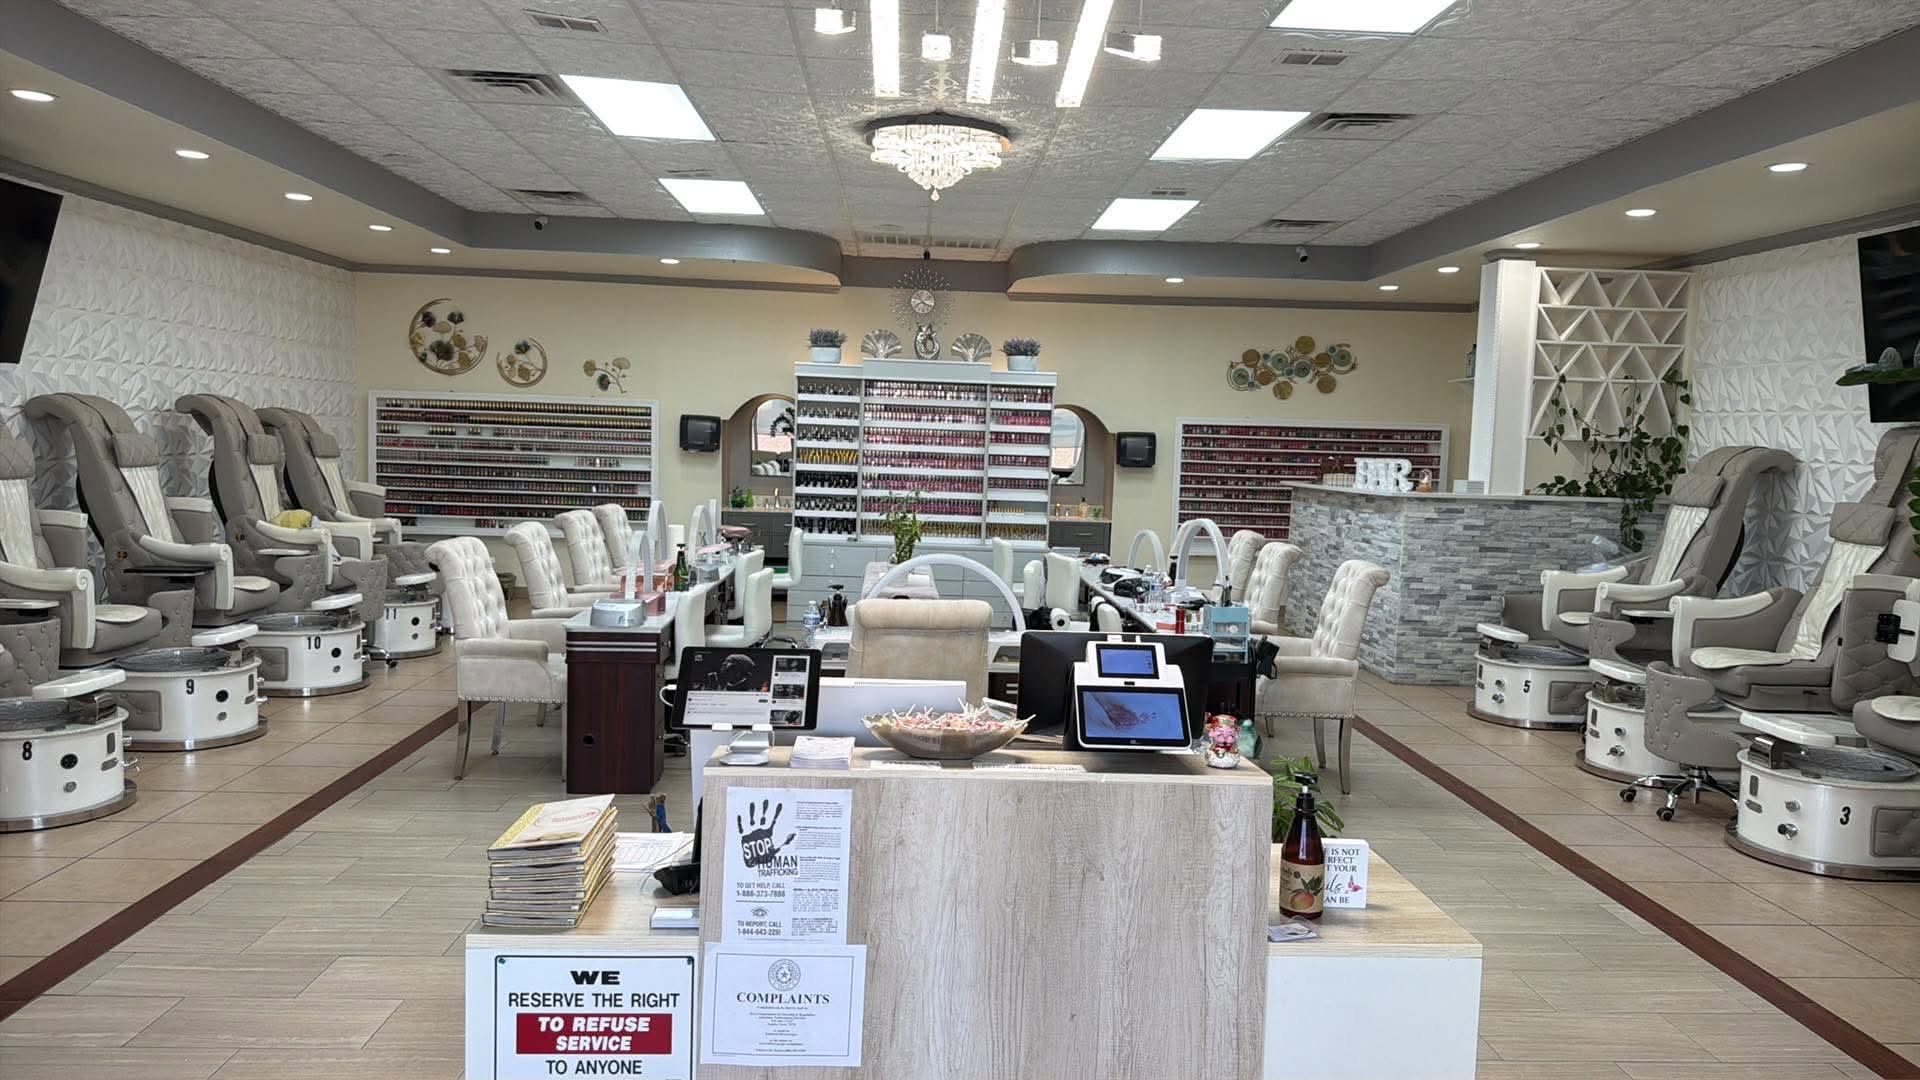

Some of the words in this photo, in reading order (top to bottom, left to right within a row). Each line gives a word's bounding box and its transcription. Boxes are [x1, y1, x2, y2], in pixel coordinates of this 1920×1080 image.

[385, 607, 397, 620] 11
[306, 636, 321, 650] 10
[185, 678, 195, 695] 9
[1522, 679, 1531, 694] 5
[21, 740, 33, 761] 8
[1839, 806, 1852, 826] 3
[743, 837, 773, 859] STOP
[1341, 848, 1360, 856] NOT
[757, 855, 798, 870] HUMAN
[1327, 856, 1354, 864] RFECT
[757, 868, 798, 878] TRAFFICKING
[1339, 896, 1350, 904] BE
[570, 970, 621, 985] WE
[508, 993, 584, 1008] RESERVE
[592, 993, 623, 1008] THE
[631, 993, 680, 1008] RIGHT
[737, 992, 830, 1005] COMPLAINTS
[538, 1017, 564, 1032] TO
[572, 1017, 650, 1032] REFUSE
[556, 1036, 632, 1051] SERVICE
[546, 1060, 568, 1075] TO
[575, 1060, 643, 1075] ANYONE
